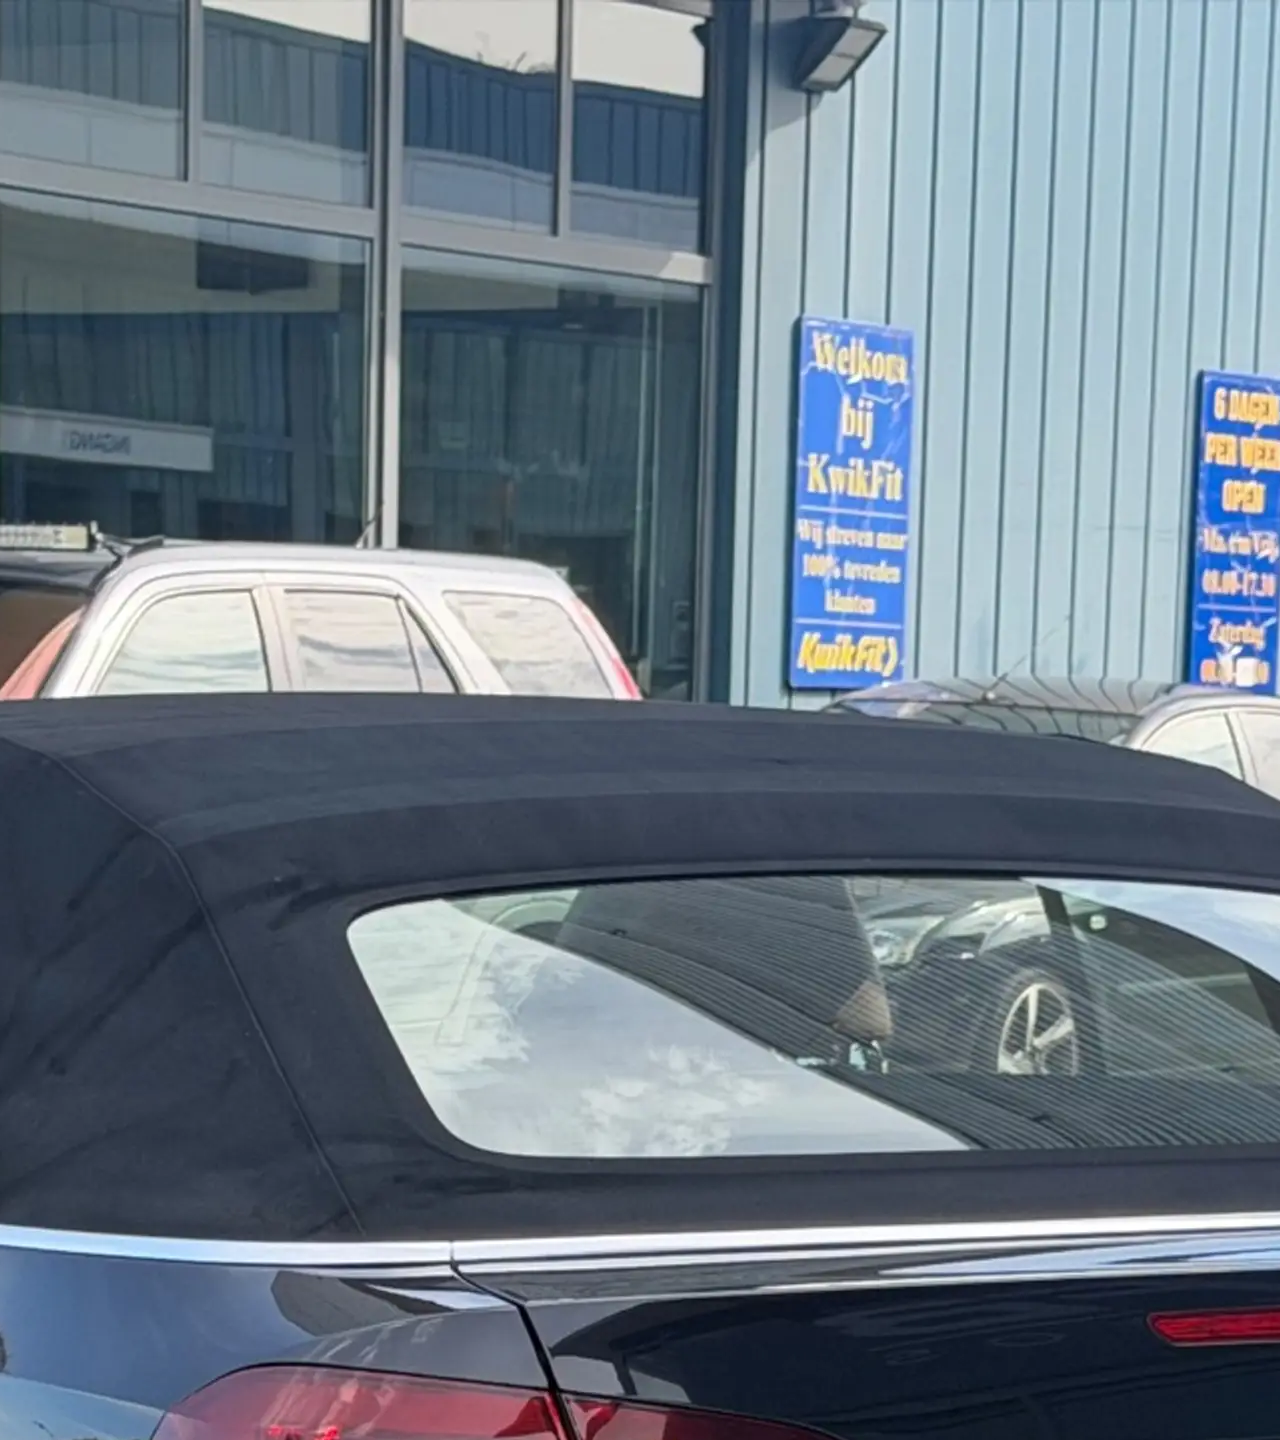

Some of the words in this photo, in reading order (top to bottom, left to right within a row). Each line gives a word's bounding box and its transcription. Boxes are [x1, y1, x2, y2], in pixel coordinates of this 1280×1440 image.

[811, 331, 909, 385] Welkom
[841, 393, 874, 450] bij
[1213, 387, 1227, 421] 6
[1205, 432, 1237, 467] PER
[807, 453, 903, 501] KwikFit
[1222, 479, 1266, 513] OPEN
